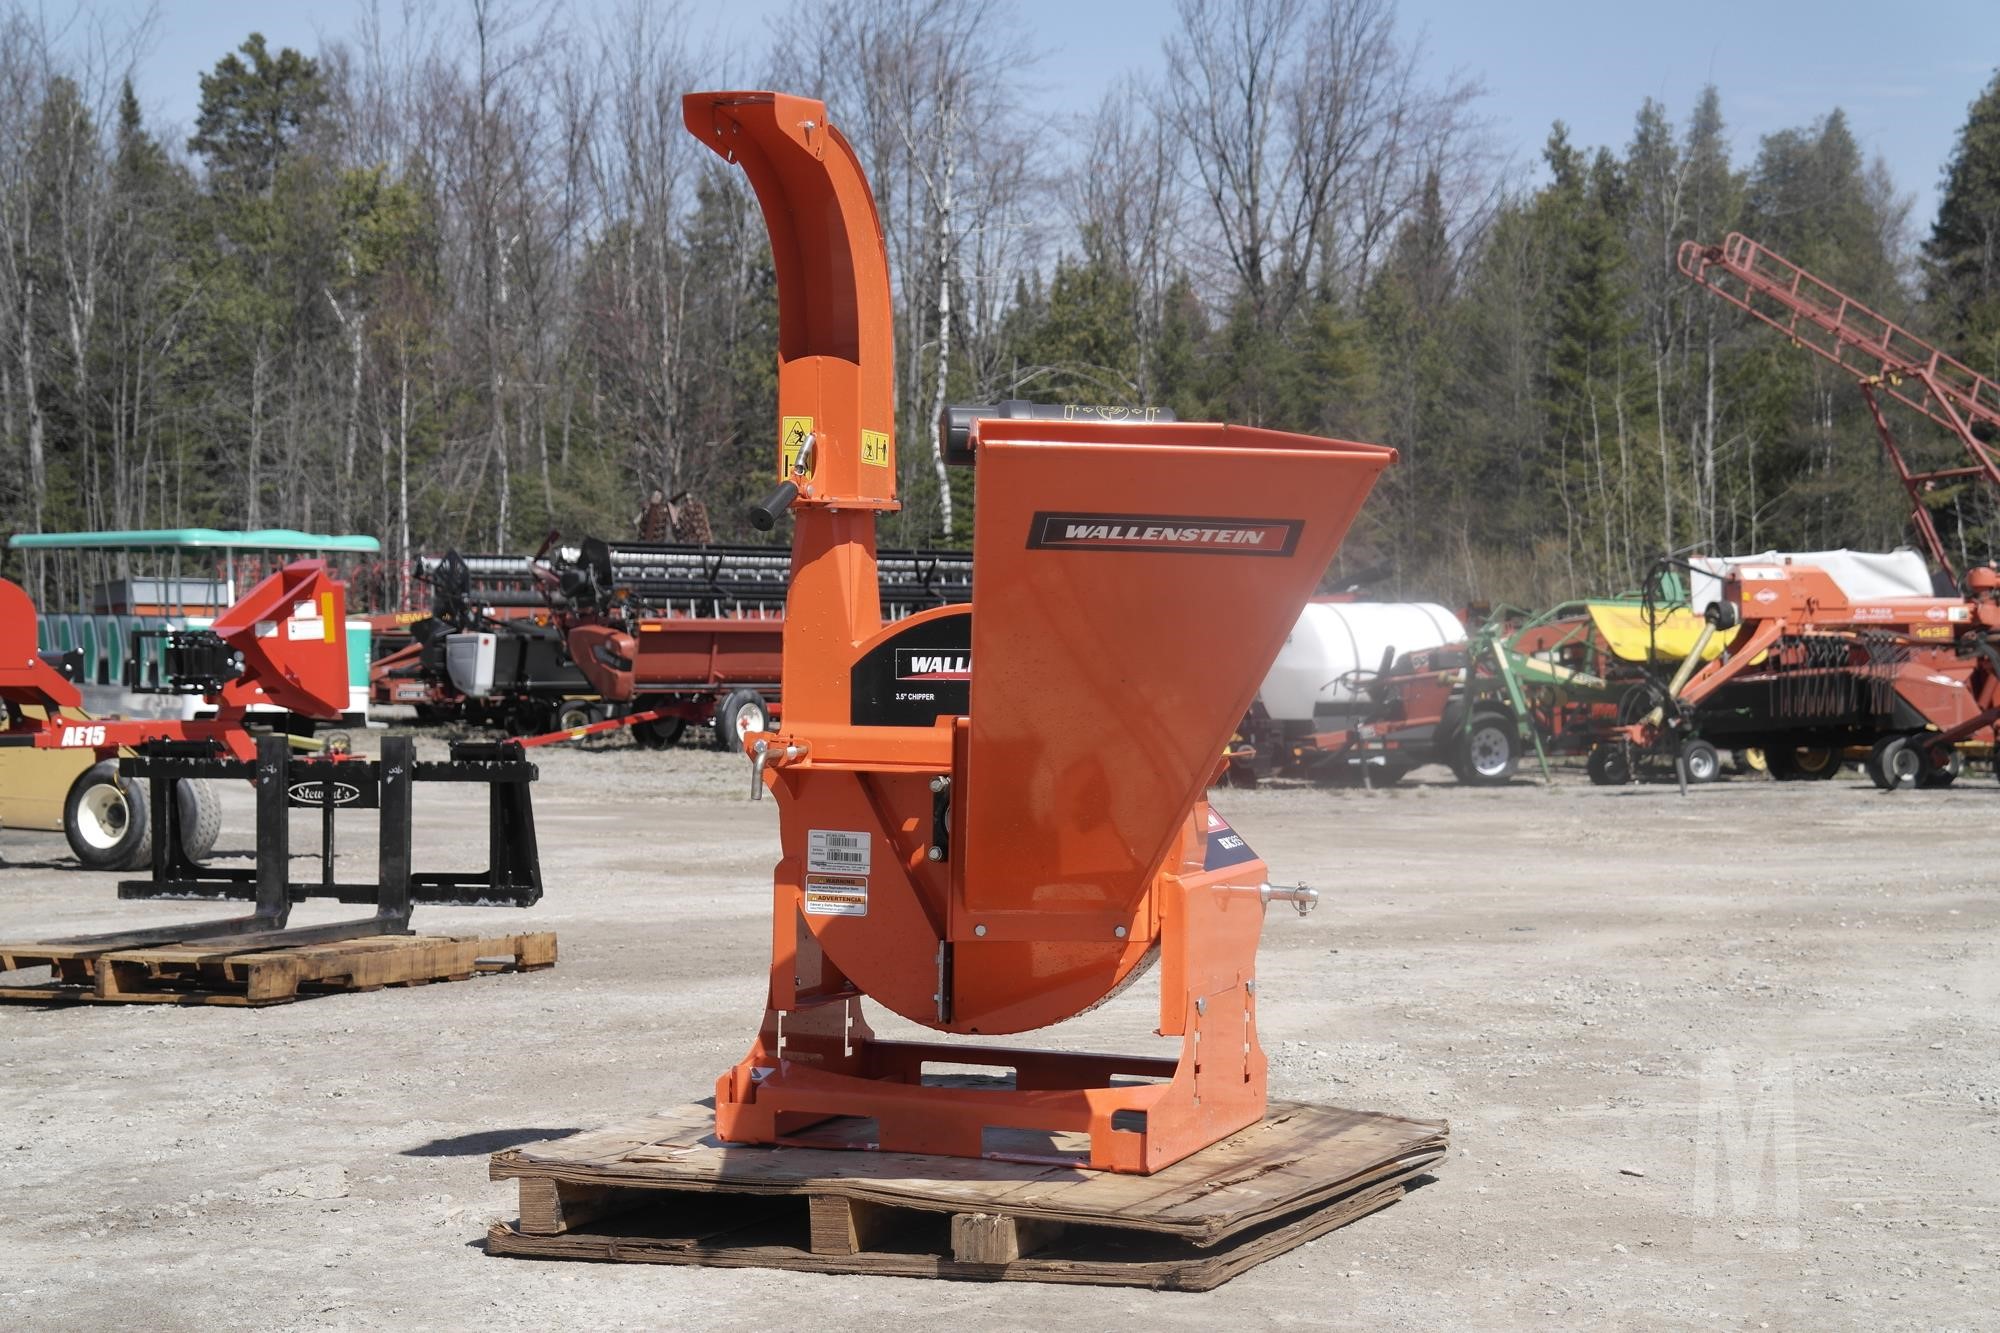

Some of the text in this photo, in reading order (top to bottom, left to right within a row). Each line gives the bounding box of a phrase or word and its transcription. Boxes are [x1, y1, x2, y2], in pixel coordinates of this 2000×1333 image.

[1065, 524, 1265, 545] WALLENSTEIN
[911, 656, 972, 673] WALL
[895, 693, 935, 701] 3.5" CHIPPER
[61, 726, 106, 747] AE15
[817, 895, 862, 903] ADVERTENCIA
